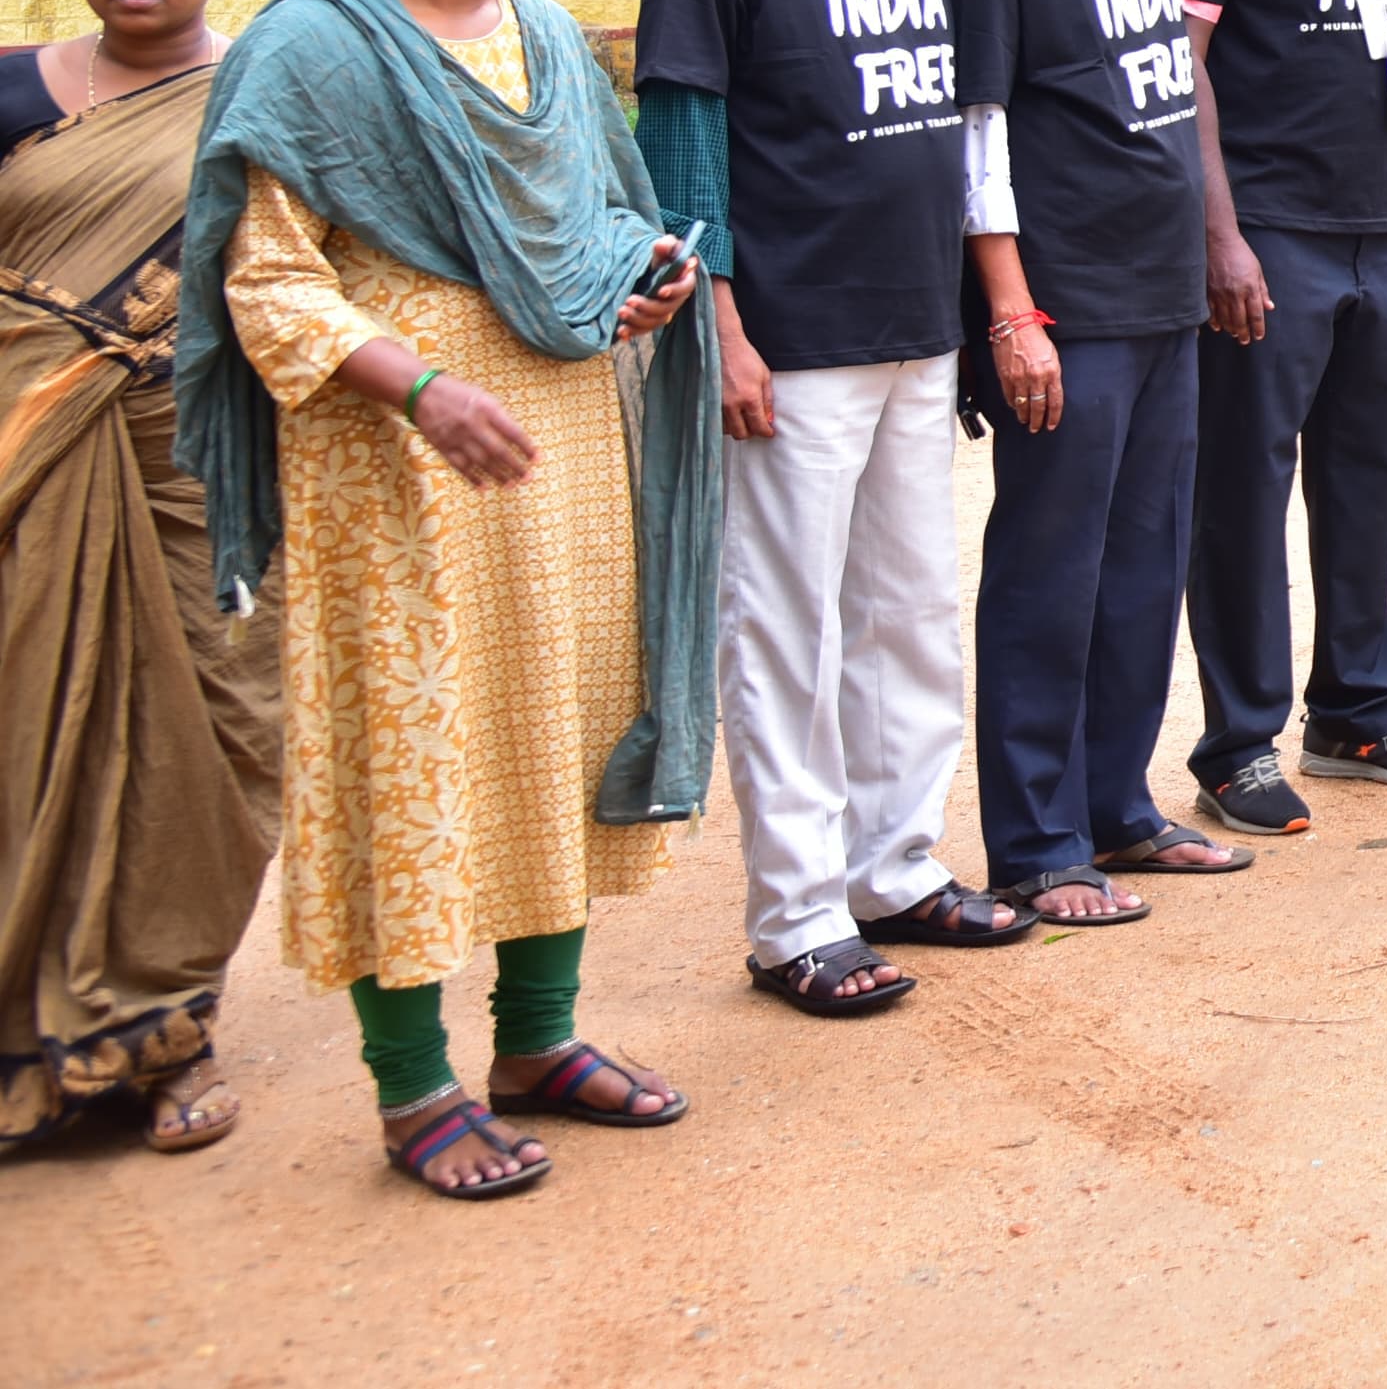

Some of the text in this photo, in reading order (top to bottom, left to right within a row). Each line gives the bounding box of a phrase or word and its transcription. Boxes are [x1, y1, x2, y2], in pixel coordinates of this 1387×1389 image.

[1300, 22, 1319, 33] OF
[846, 128, 868, 142] OF
[873, 120, 924, 138] HUMAN
